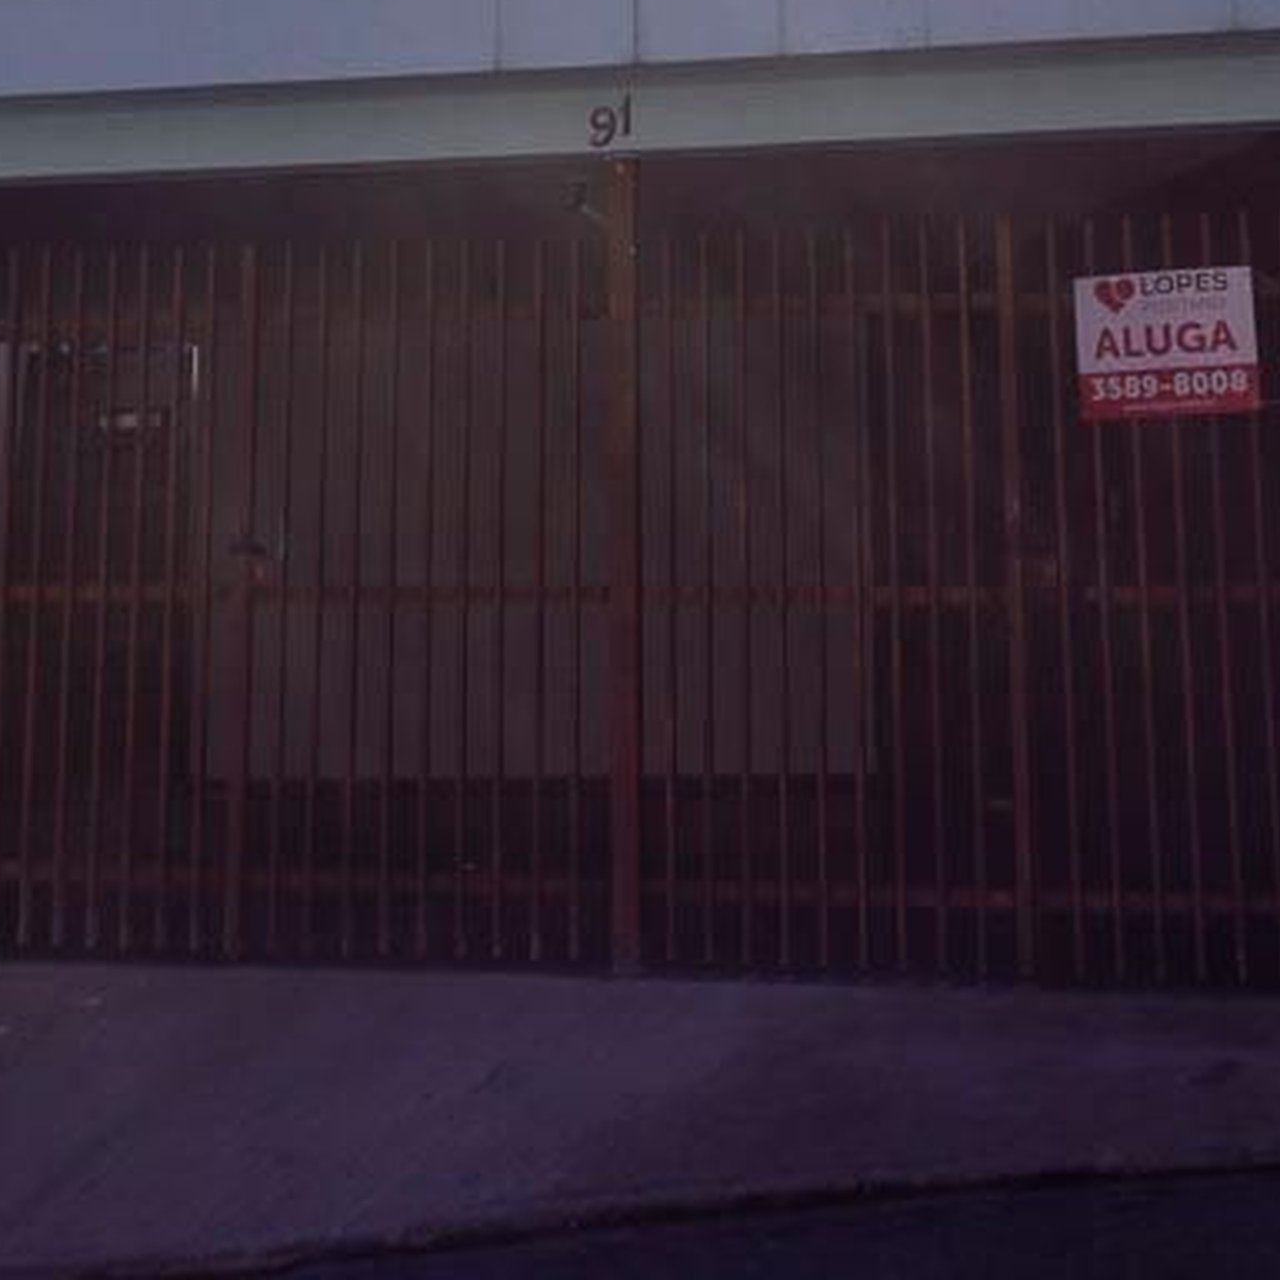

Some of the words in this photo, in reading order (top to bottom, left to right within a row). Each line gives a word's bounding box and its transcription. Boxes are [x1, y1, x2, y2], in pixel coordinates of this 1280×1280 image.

[589, 94, 632, 148] 91
[1139, 271, 1228, 297] LOPES
[1094, 319, 1239, 360] ALUGA
[1091, 370, 1249, 402] 3589-8008
